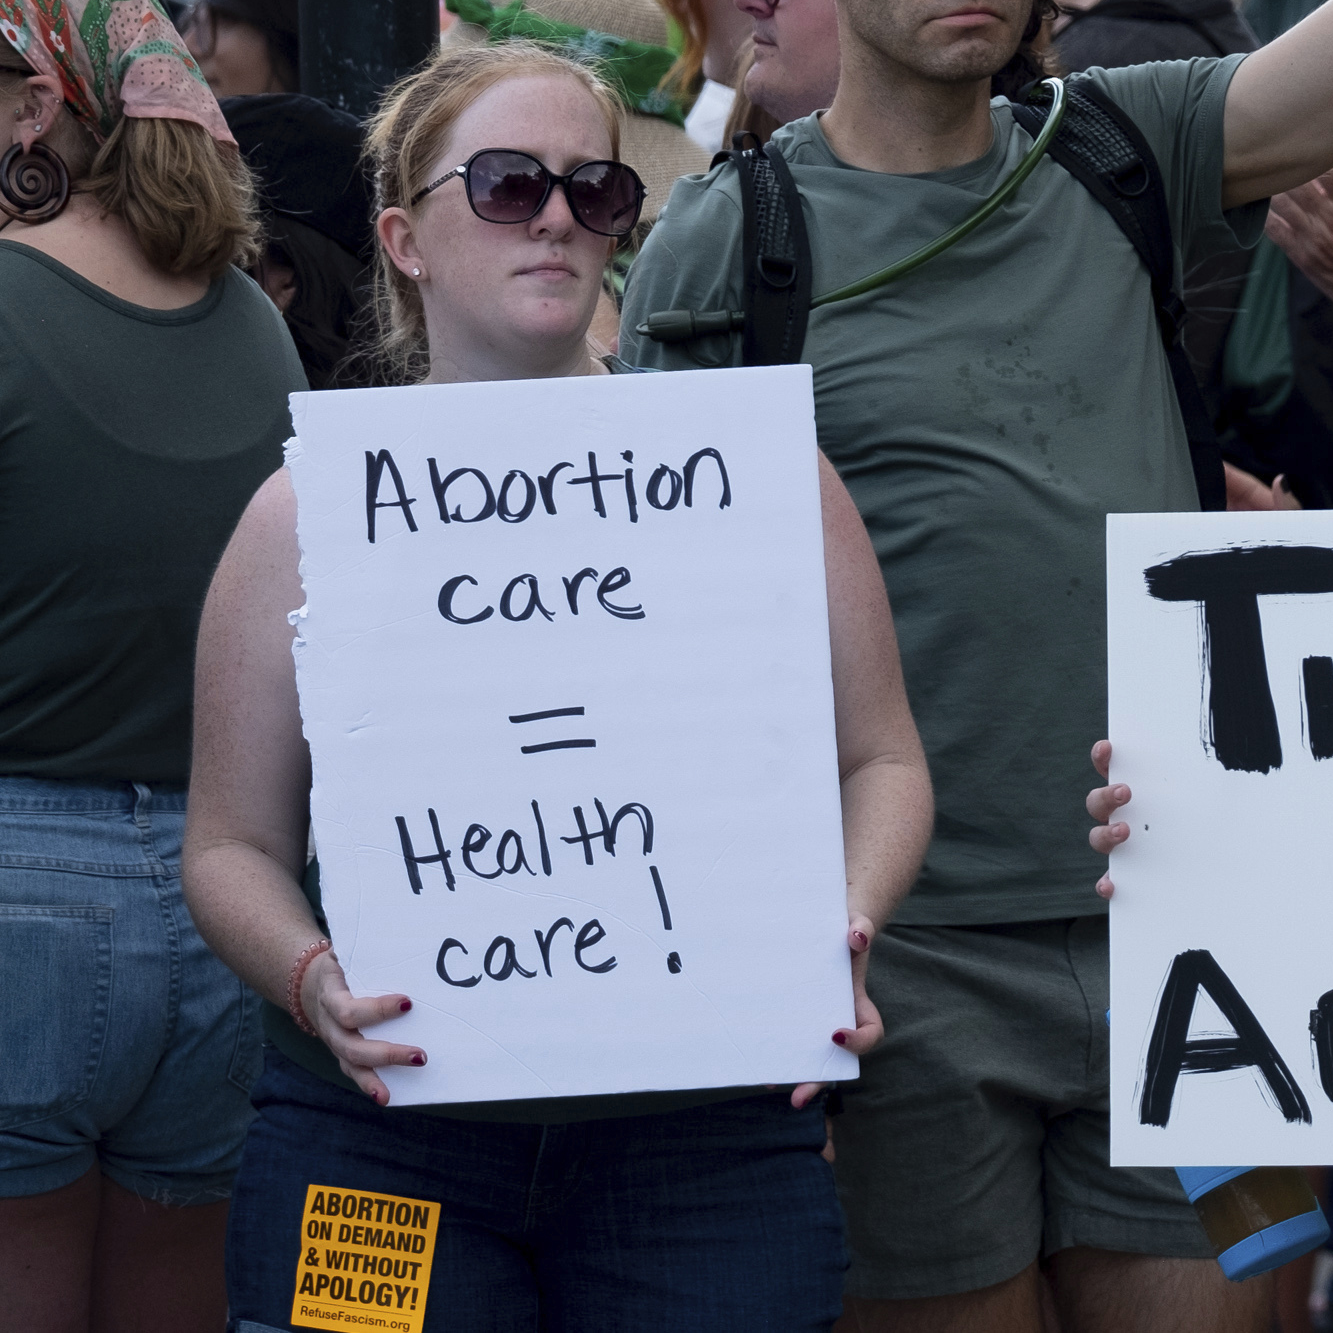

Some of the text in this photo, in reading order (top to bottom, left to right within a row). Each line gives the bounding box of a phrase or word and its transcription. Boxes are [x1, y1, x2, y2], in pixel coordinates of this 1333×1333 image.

[365, 448, 731, 543] Abortion
[438, 567, 645, 624] care
[395, 798, 657, 895] Health
[310, 1191, 430, 1230] ABORTION
[307, 1219, 427, 1254] ON DEMAND
[304, 1247, 422, 1281] & WITHOUT
[299, 1272, 419, 1310] APOLOGY!
[300, 1306, 411, 1333] RefuseFascism.org
